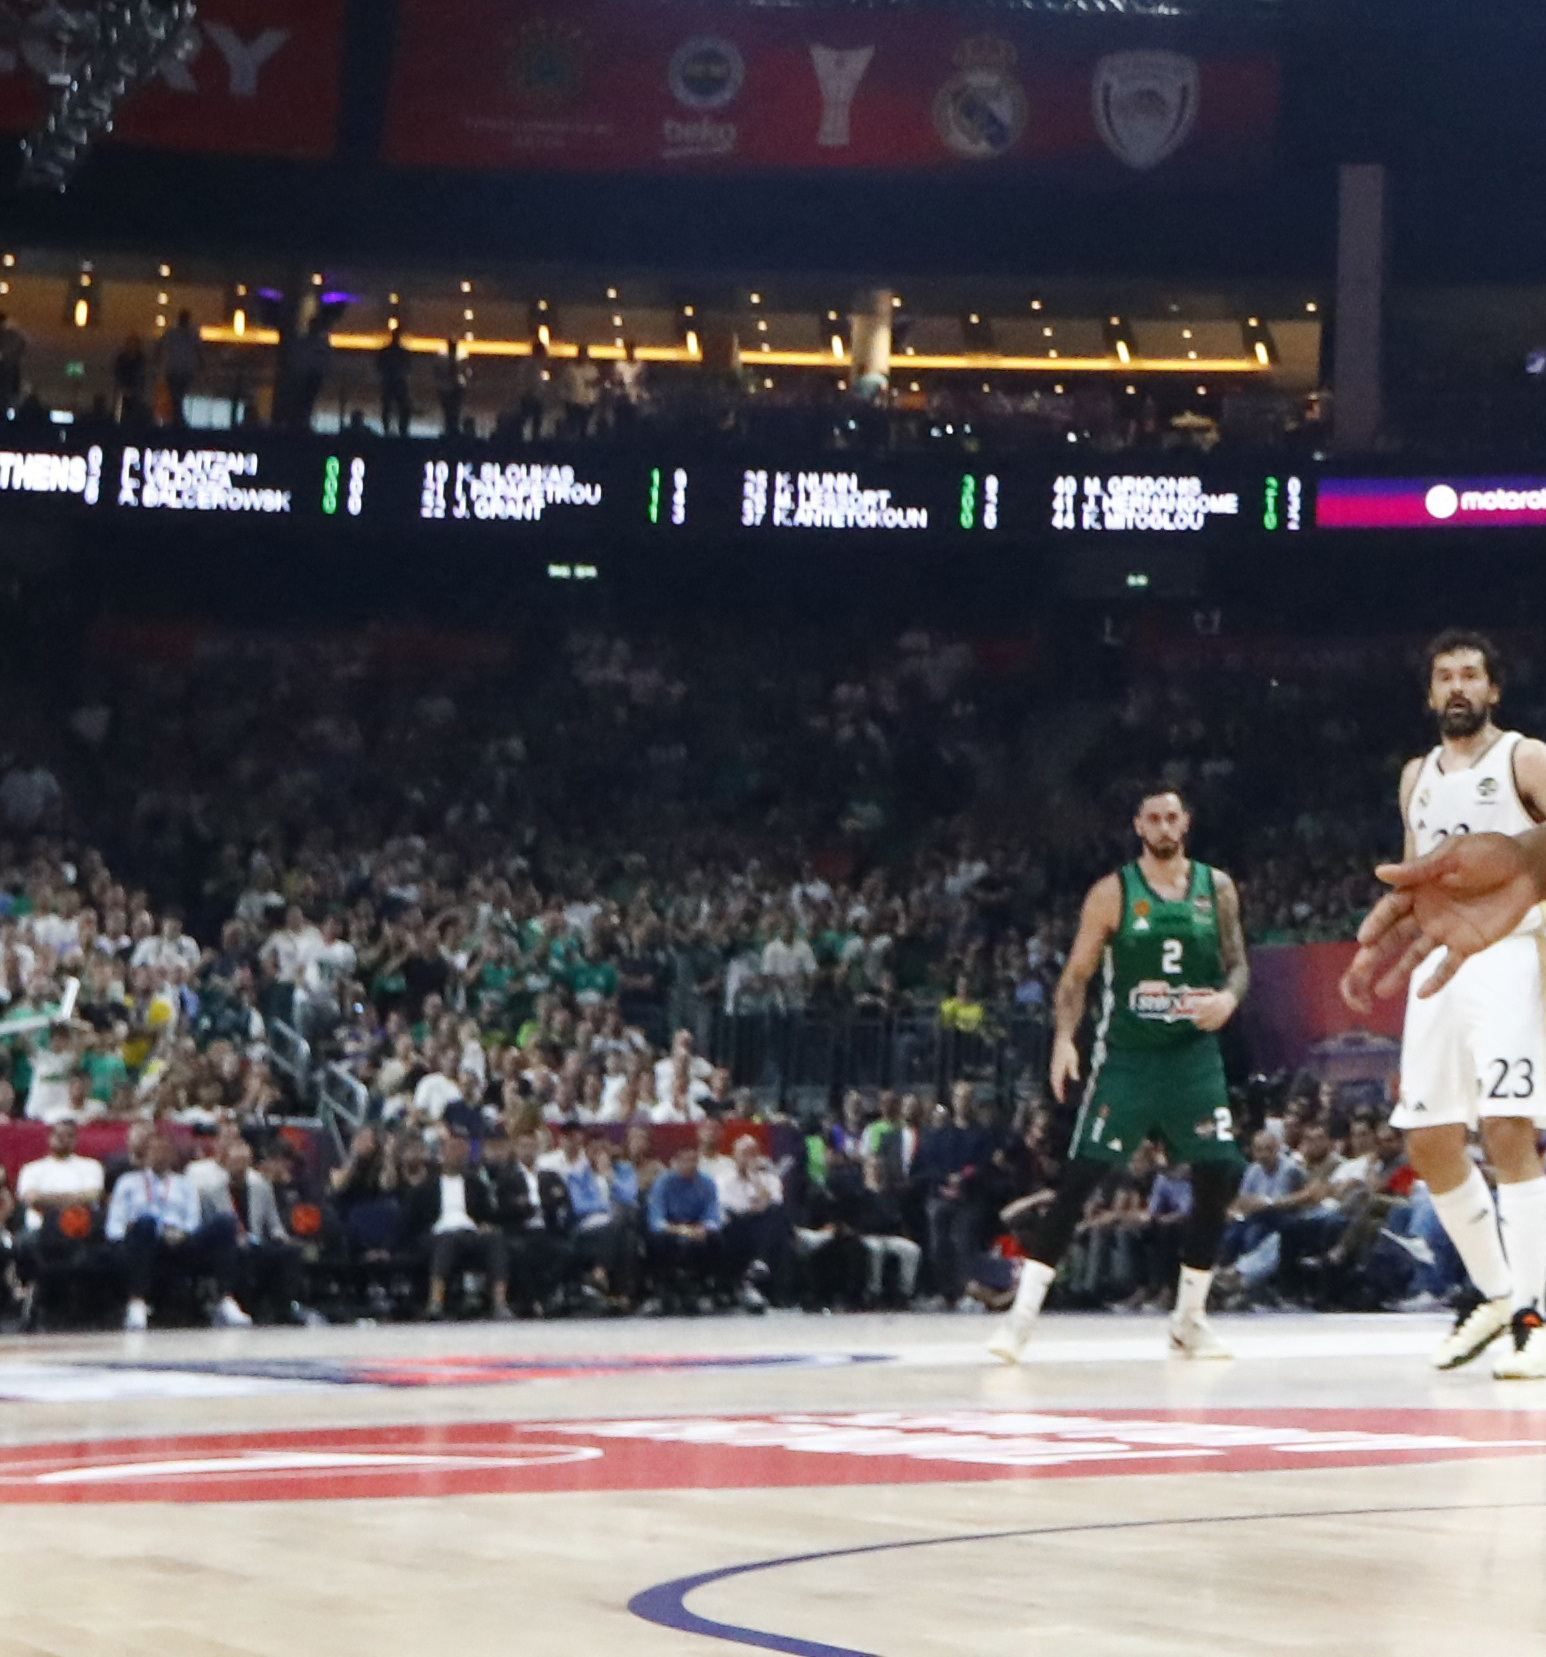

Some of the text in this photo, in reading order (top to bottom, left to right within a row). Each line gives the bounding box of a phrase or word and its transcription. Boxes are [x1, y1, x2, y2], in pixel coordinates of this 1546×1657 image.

[1162, 939, 1183, 974] 2
[1488, 1057, 1535, 1099] 23
[1213, 1106, 1234, 1142] 2
